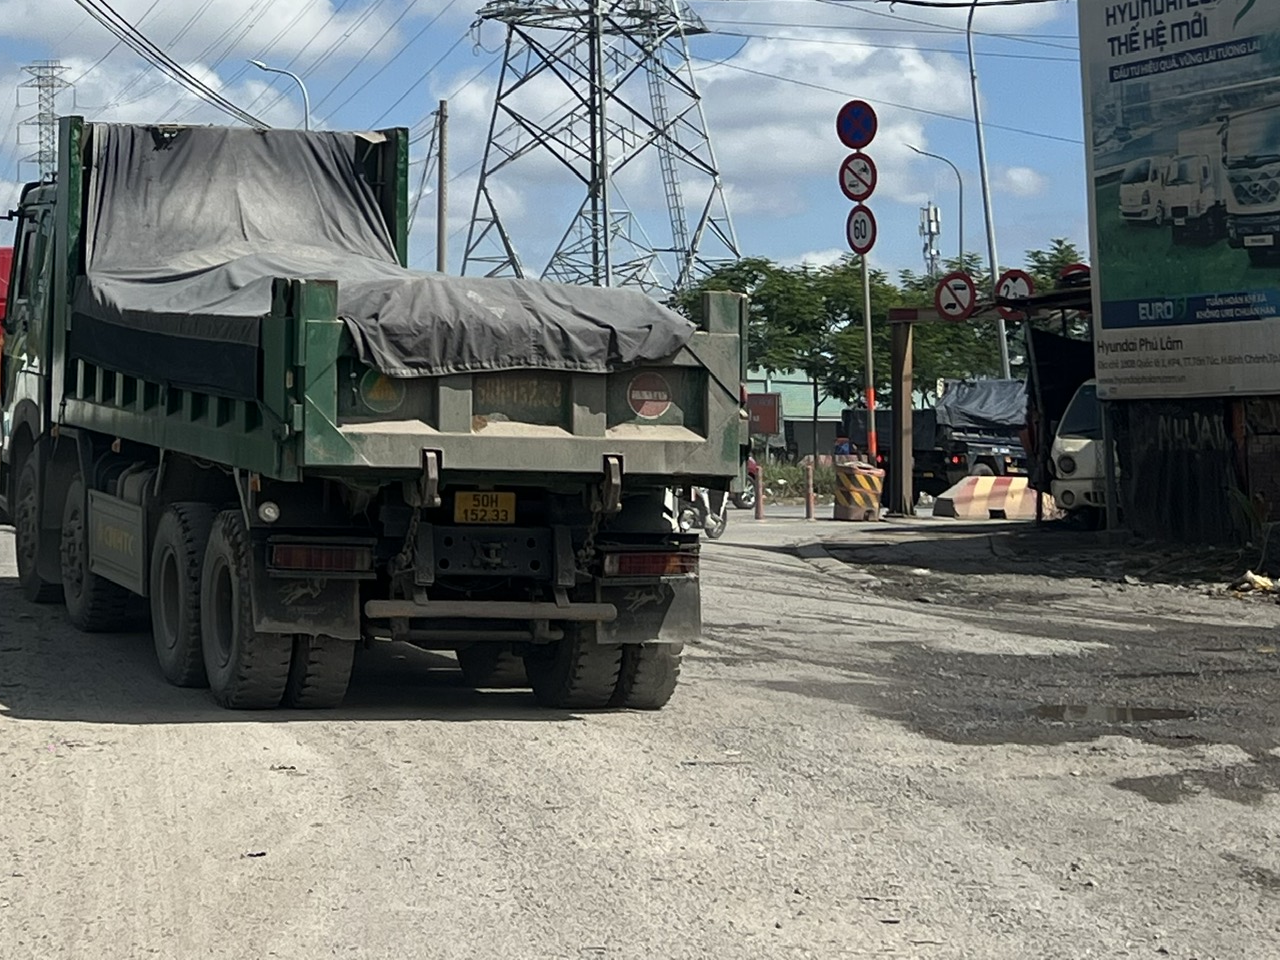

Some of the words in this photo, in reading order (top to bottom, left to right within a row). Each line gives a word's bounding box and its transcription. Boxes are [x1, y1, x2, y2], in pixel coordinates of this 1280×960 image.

[1107, 22, 1140, 57] THẾ
[1144, 20, 1166, 52] HỆ
[854, 219, 867, 240] 60
[1138, 301, 1174, 320] EURO
[1097, 337, 1137, 355] Hyundai
[1160, 335, 1183, 351] Lâm
[472, 494, 499, 508] 50H
[463, 508, 509, 522] 152.33
